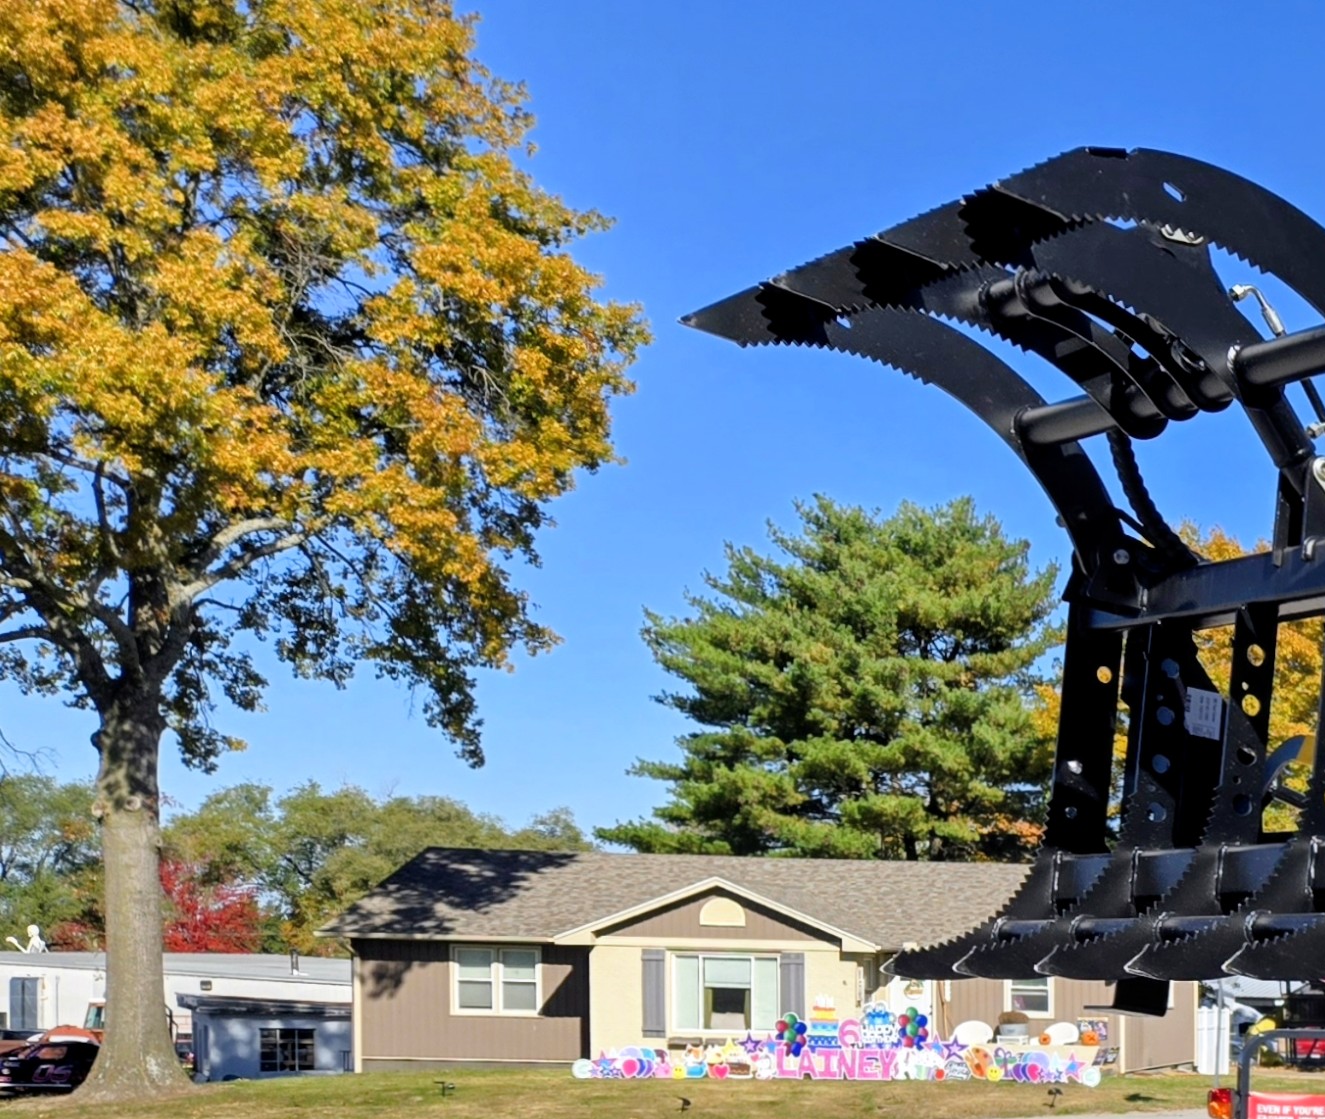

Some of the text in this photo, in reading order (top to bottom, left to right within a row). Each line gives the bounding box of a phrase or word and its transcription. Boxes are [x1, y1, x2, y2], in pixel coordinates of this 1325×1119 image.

[775, 1046, 898, 1080] LAINEY
[1256, 1103, 1280, 1115] EVEN
[1282, 1104, 1291, 1114] IF
[1293, 1105, 1325, 1116] YOU'RE
